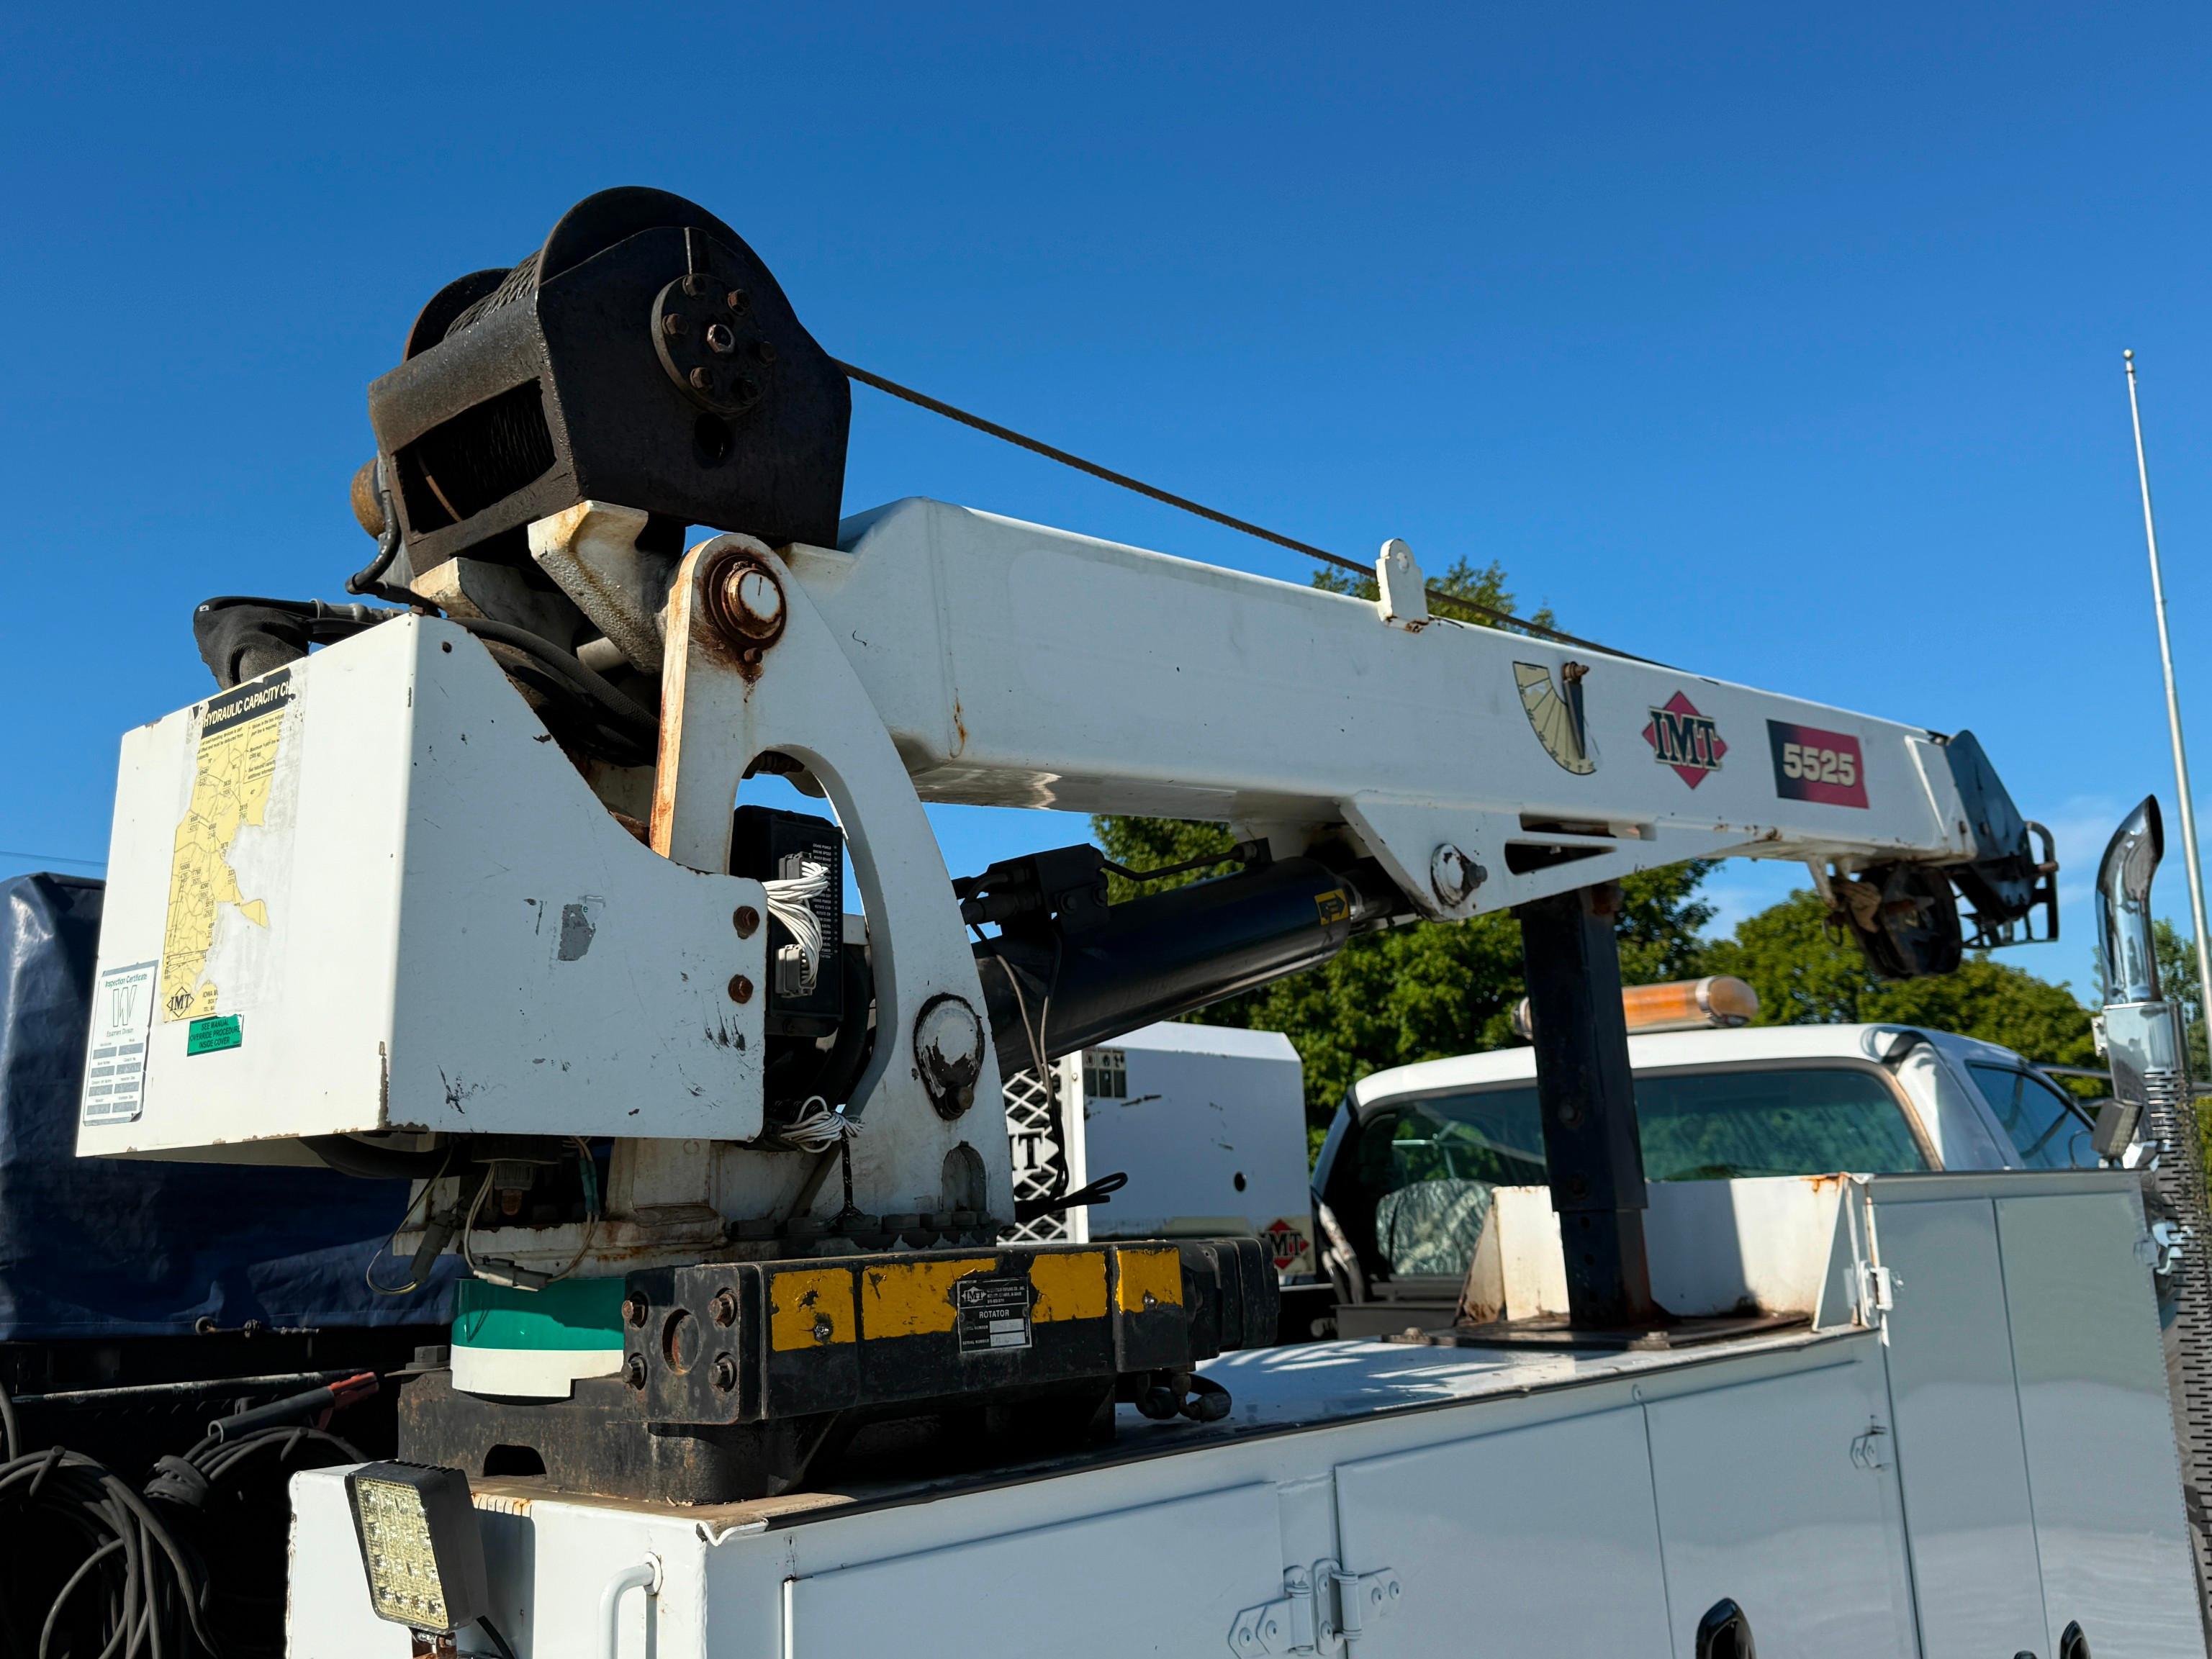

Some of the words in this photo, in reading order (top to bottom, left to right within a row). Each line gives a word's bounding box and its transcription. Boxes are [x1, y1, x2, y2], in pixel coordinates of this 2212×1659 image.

[203, 700, 243, 728] HYDRAULIC
[243, 685, 280, 712] CAPACITY
[1647, 707, 1723, 771] IMT
[1783, 743, 1856, 787] 5525
[105, 977, 126, 989] Inspection
[126, 973, 148, 983] Certificate
[169, 993, 191, 1011] IMT
[211, 1019, 230, 1029] MANUAL
[190, 1031, 212, 1041] OVERRIDE
[212, 1026, 240, 1037] PROCEDURE
[199, 1039, 215, 1049] INSIDE
[215, 1036, 230, 1046] COVER
[1258, 1231, 1303, 1256] MT
[965, 1289, 984, 1302] IMT
[979, 1309, 1010, 1319] ROTATOR
